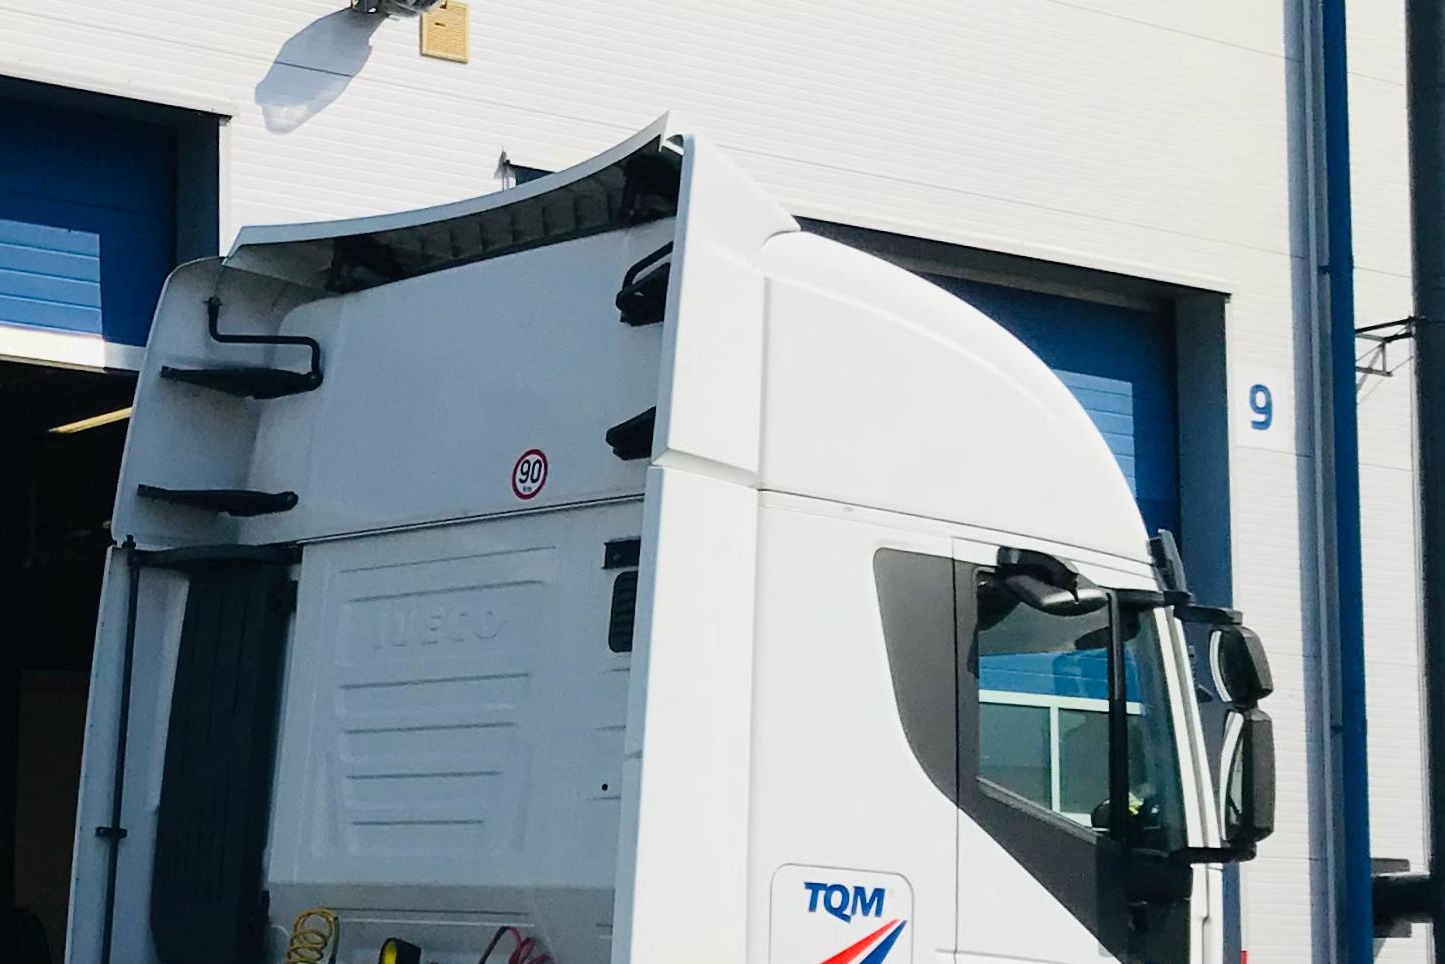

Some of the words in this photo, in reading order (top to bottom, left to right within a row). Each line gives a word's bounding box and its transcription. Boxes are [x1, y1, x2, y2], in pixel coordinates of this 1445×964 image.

[1249, 383, 1273, 431] 9
[518, 458, 543, 484] 90
[804, 881, 886, 924] TQM
